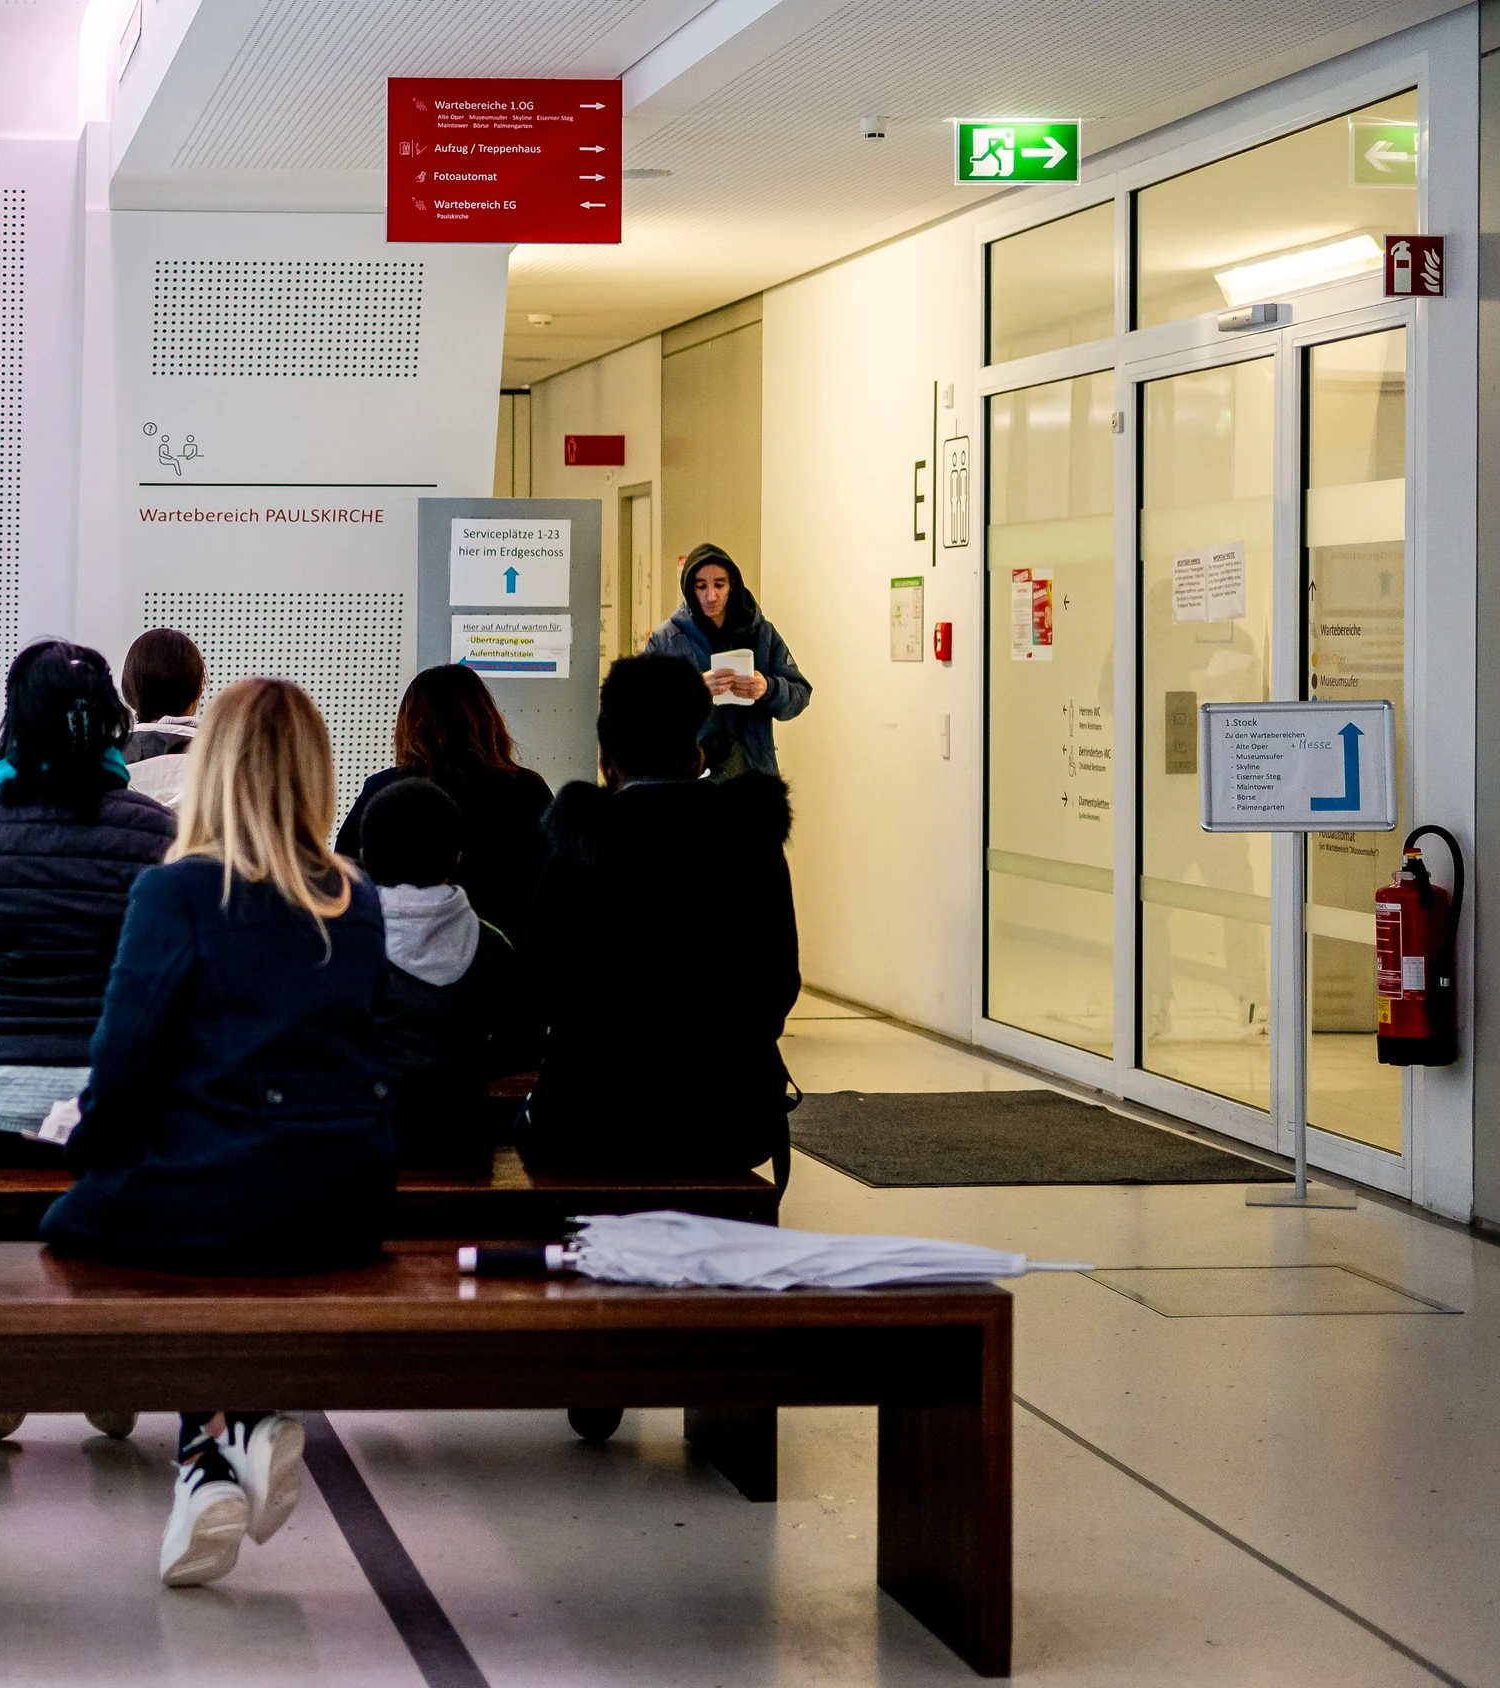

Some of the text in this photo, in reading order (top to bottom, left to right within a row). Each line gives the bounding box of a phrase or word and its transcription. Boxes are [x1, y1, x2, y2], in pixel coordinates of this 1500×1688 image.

[434, 100, 534, 111] Wartebereiche 1.OG
[434, 143, 541, 156] Aufzug / Treppenhaus
[433, 172, 497, 181] Fotoautomat
[434, 200, 517, 210] Wartebereich EG
[139, 508, 385, 523] Wartebereich PAULSKIRCHE
[463, 528, 560, 541] Serviceplätze 1-23
[458, 546, 564, 558] hier im Erdgeschoss
[481, 623, 494, 631] auf
[495, 623, 520, 631] Aufruf
[549, 623, 562, 631] für:
[1320, 623, 1362, 636] Wartebereiche
[469, 649, 534, 658] Aufenthaltstiteln
[1319, 674, 1359, 688] Museumsufer
[1225, 718, 1258, 727] 1.Stock
[1250, 731, 1305, 739] Wartebereichen
[1251, 743, 1269, 751] Oper
[1299, 739, 1333, 750] Messe
[1236, 763, 1260, 771] Skyline
[1265, 773, 1281, 781] Steg
[1079, 796, 1109, 809] Damentoiletten
